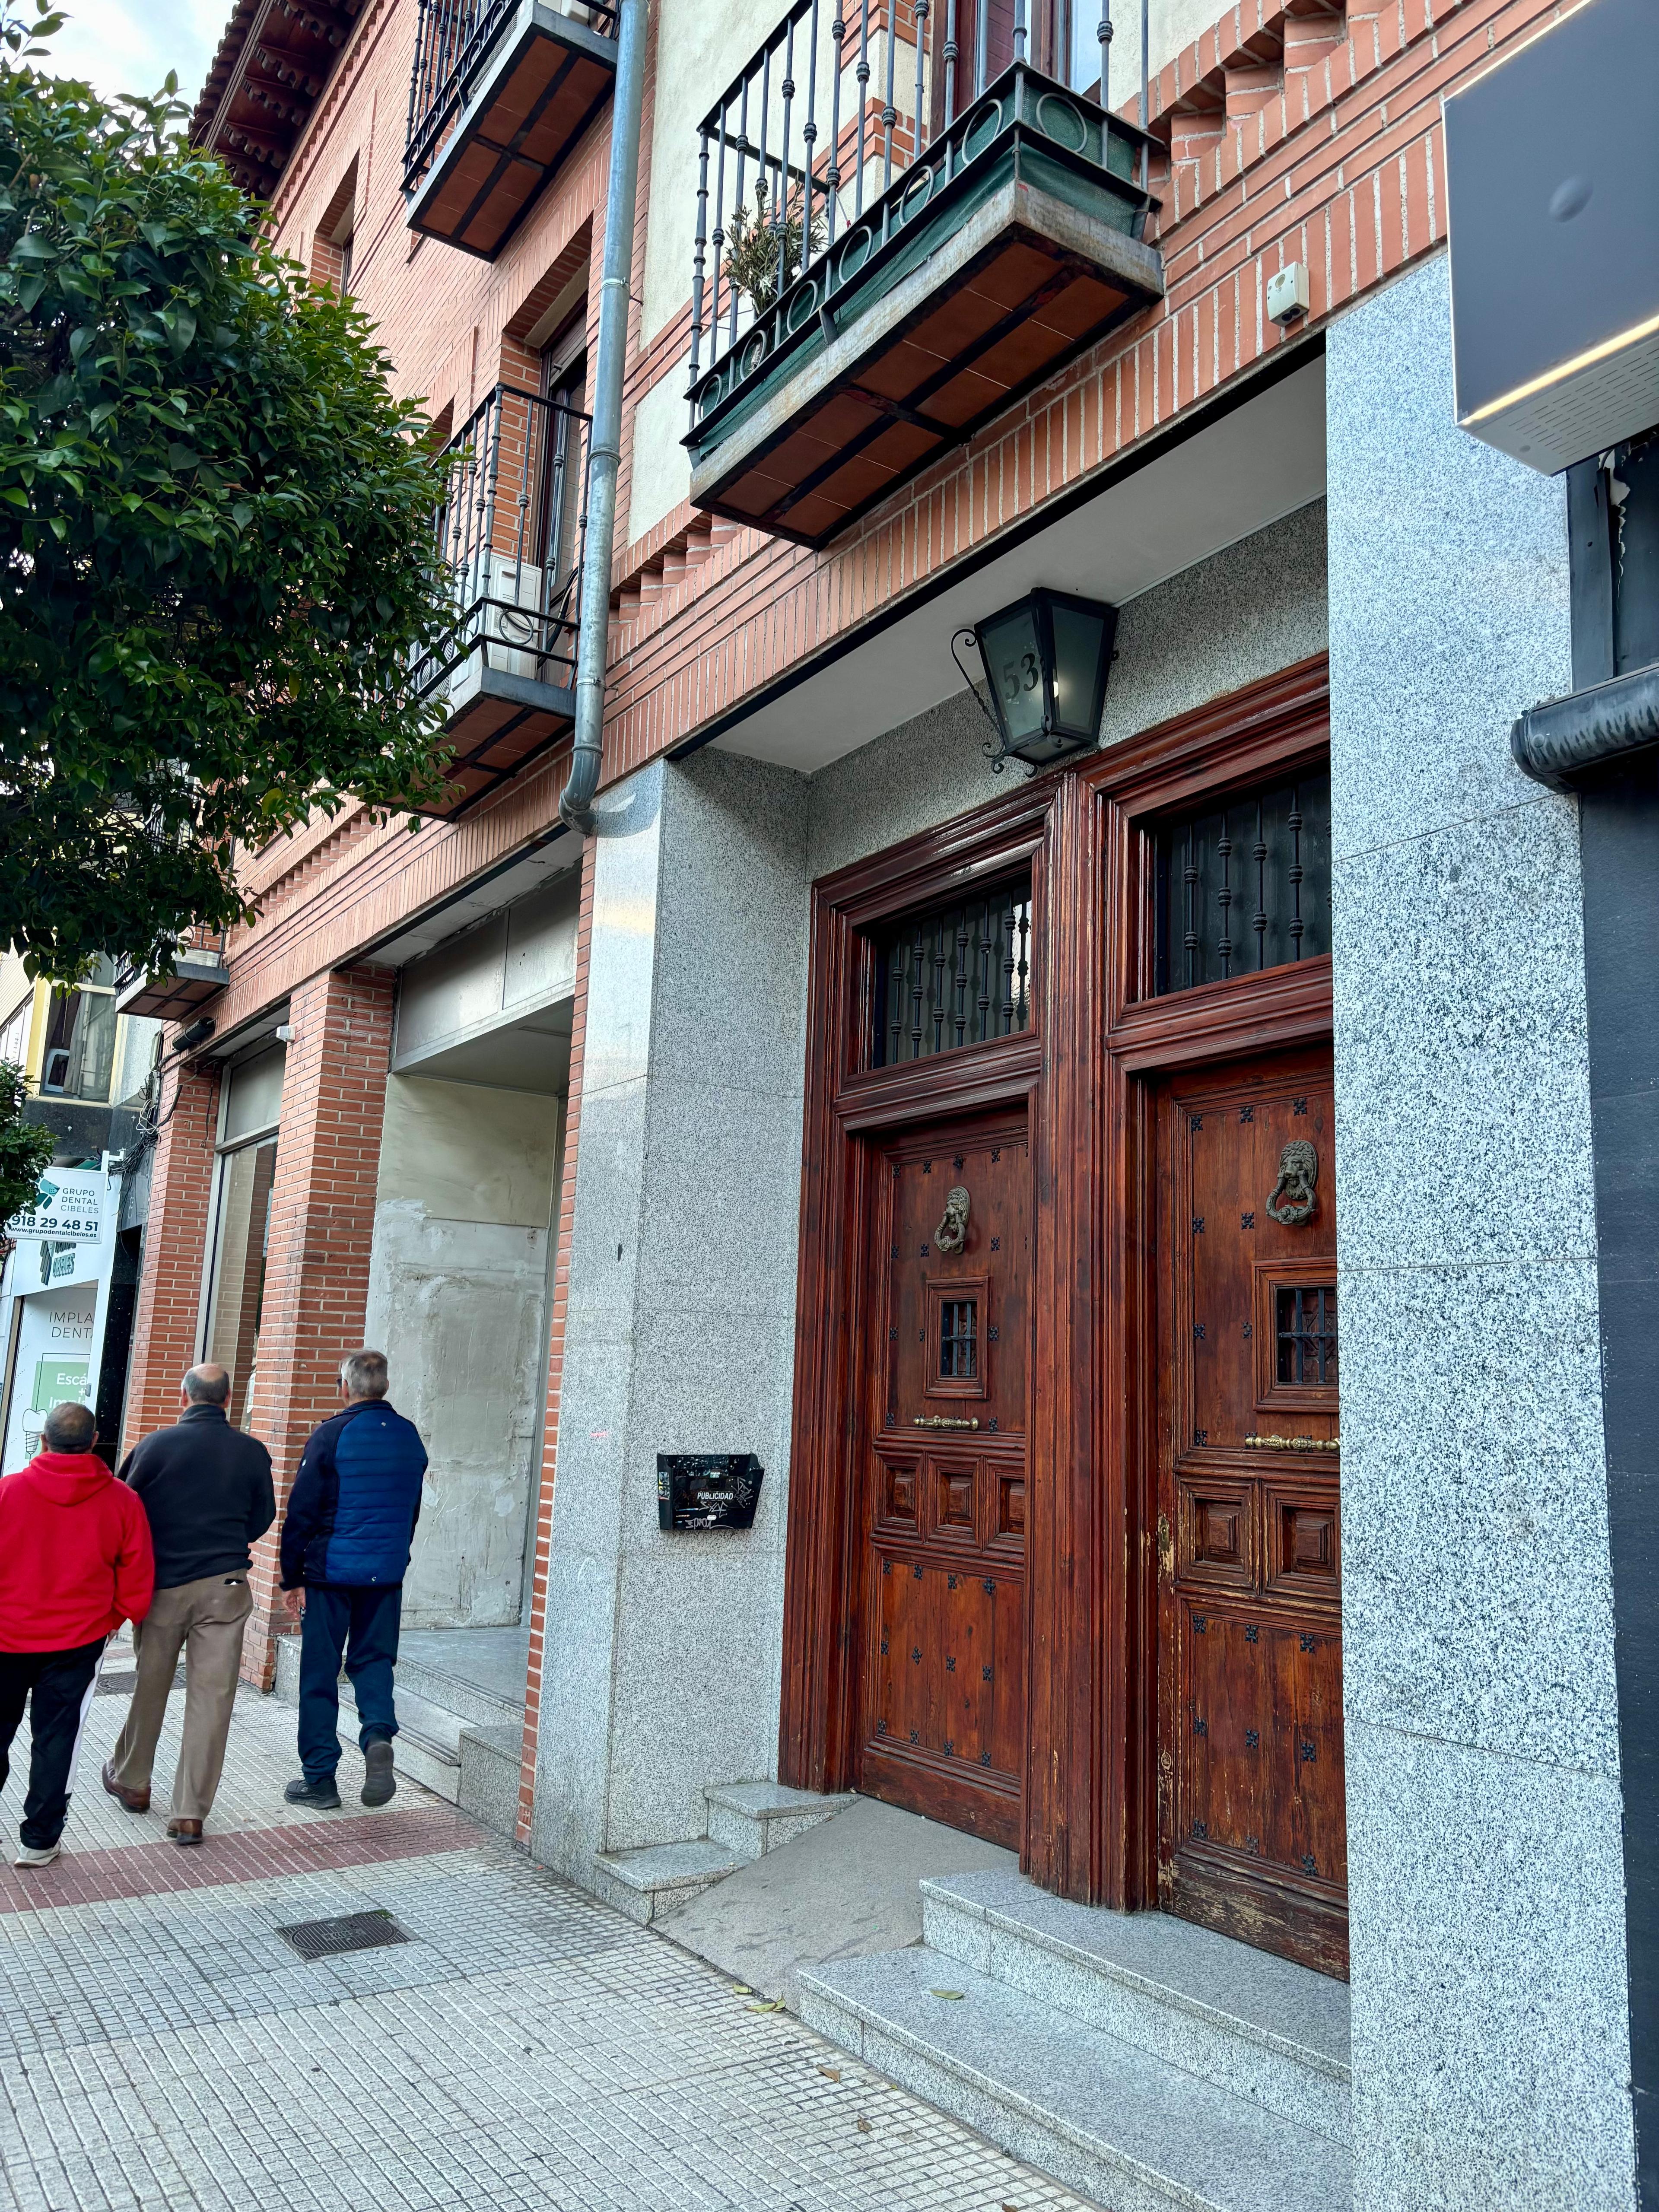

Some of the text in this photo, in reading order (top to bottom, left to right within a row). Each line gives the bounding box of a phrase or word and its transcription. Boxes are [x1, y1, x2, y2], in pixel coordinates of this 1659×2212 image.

[1003, 653, 1039, 699] 53
[63, 1188, 95, 1196] GRUPO
[62, 1196, 98, 1205] DENTAL
[61, 1205, 99, 1214] CIBELES
[12, 1215, 99, 1232] 918 29 48 51
[10, 1227, 97, 1238] www.grupodentalcibeles.es
[51, 1327, 92, 1338] DENT
